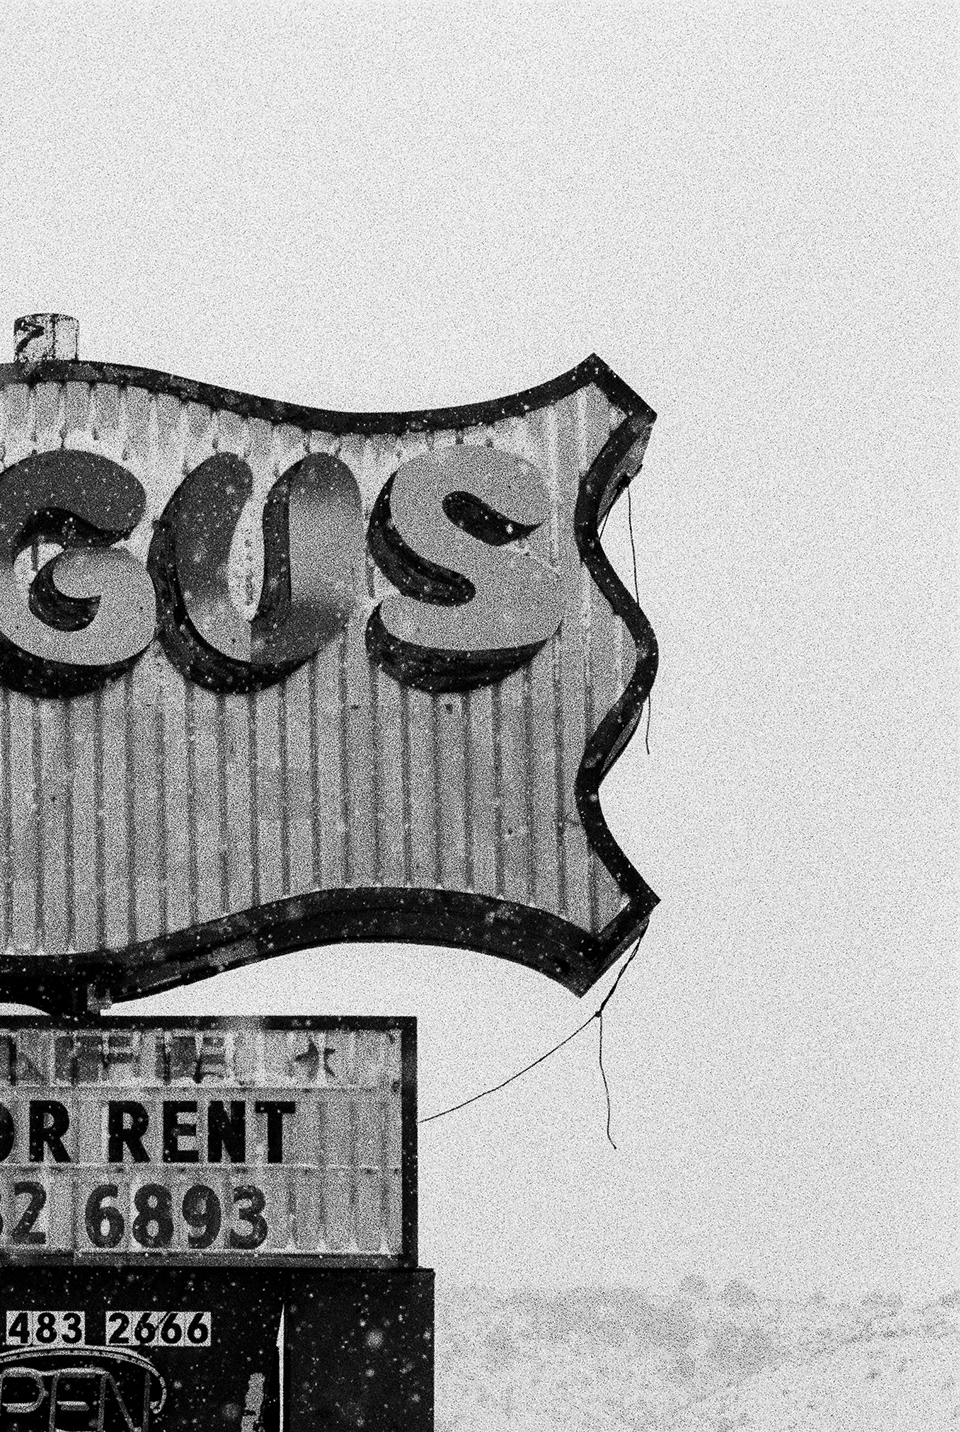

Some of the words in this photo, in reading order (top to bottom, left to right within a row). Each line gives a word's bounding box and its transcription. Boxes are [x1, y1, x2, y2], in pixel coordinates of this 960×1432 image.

[108, 1102, 296, 1163] RENT
[84, 1184, 268, 1251] 6893
[8, 1312, 82, 1344] 483
[108, 1312, 209, 1345] 2666
